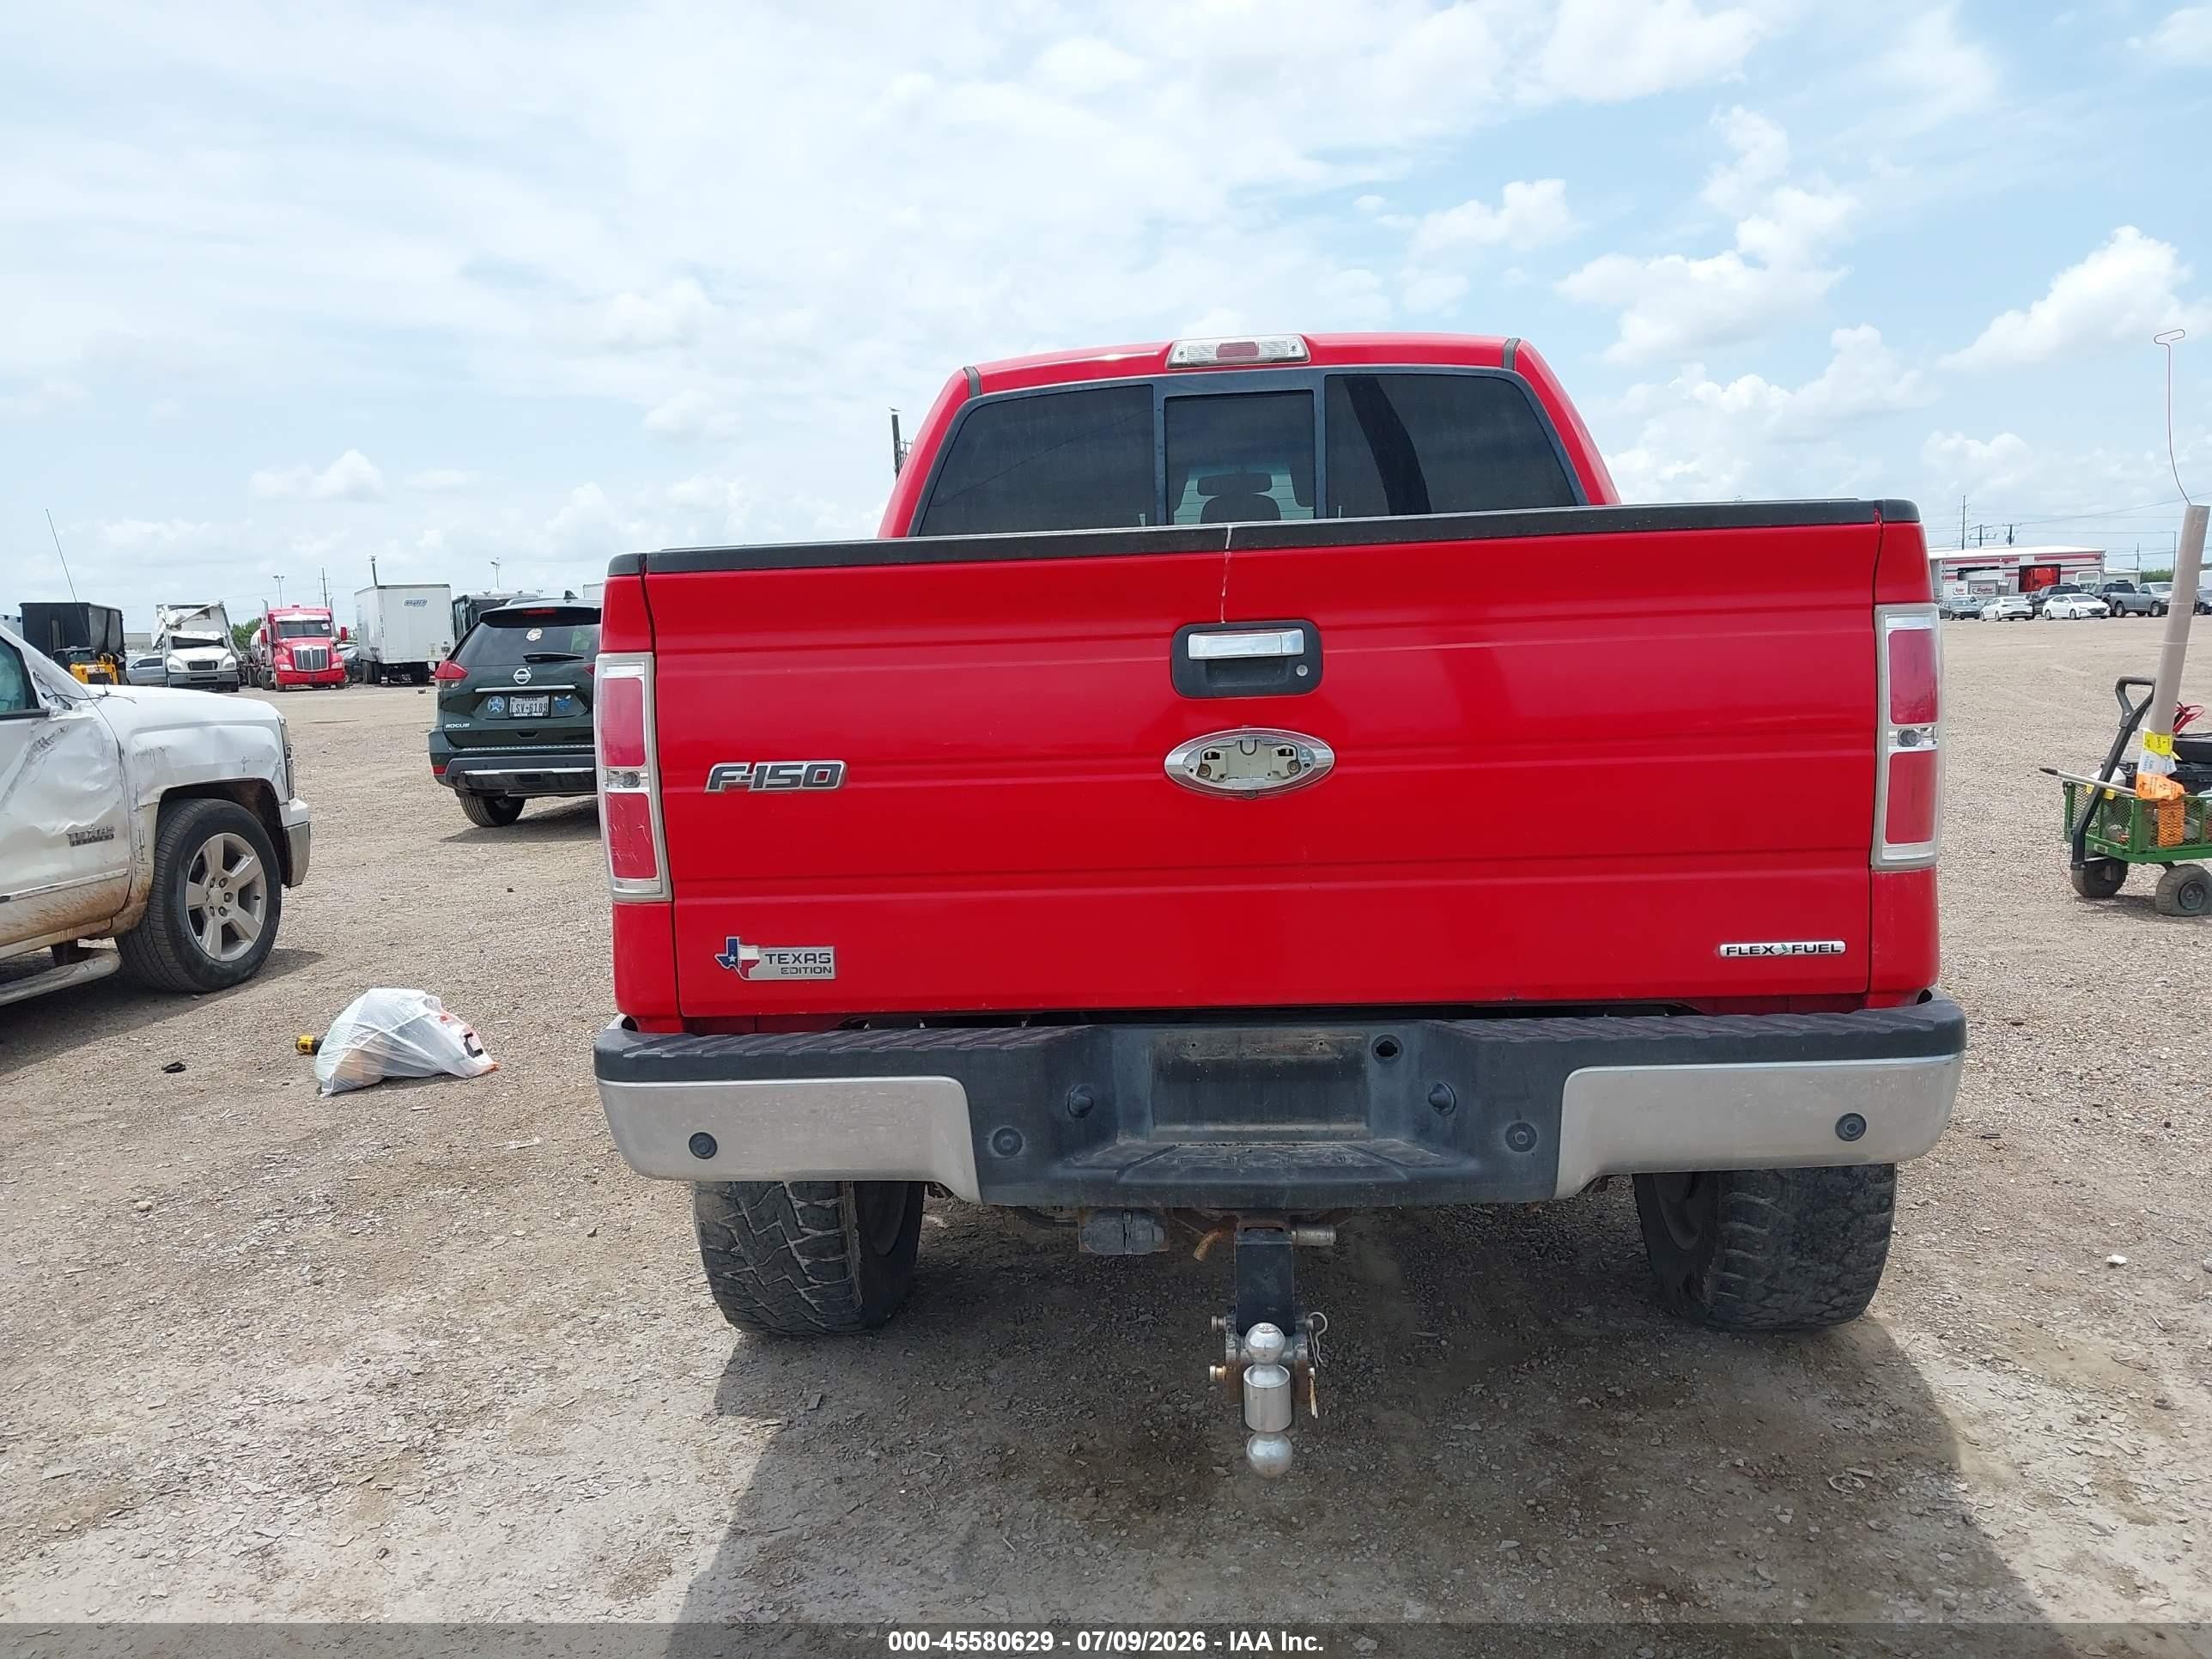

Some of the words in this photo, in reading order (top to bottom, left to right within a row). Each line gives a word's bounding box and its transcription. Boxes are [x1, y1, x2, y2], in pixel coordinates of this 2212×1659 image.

[704, 759, 848, 794] F-150
[1726, 945, 1776, 956] FLEX
[1791, 943, 1842, 954] FUEL
[764, 952, 832, 965] TEXAS
[781, 966, 832, 975] EDITION
